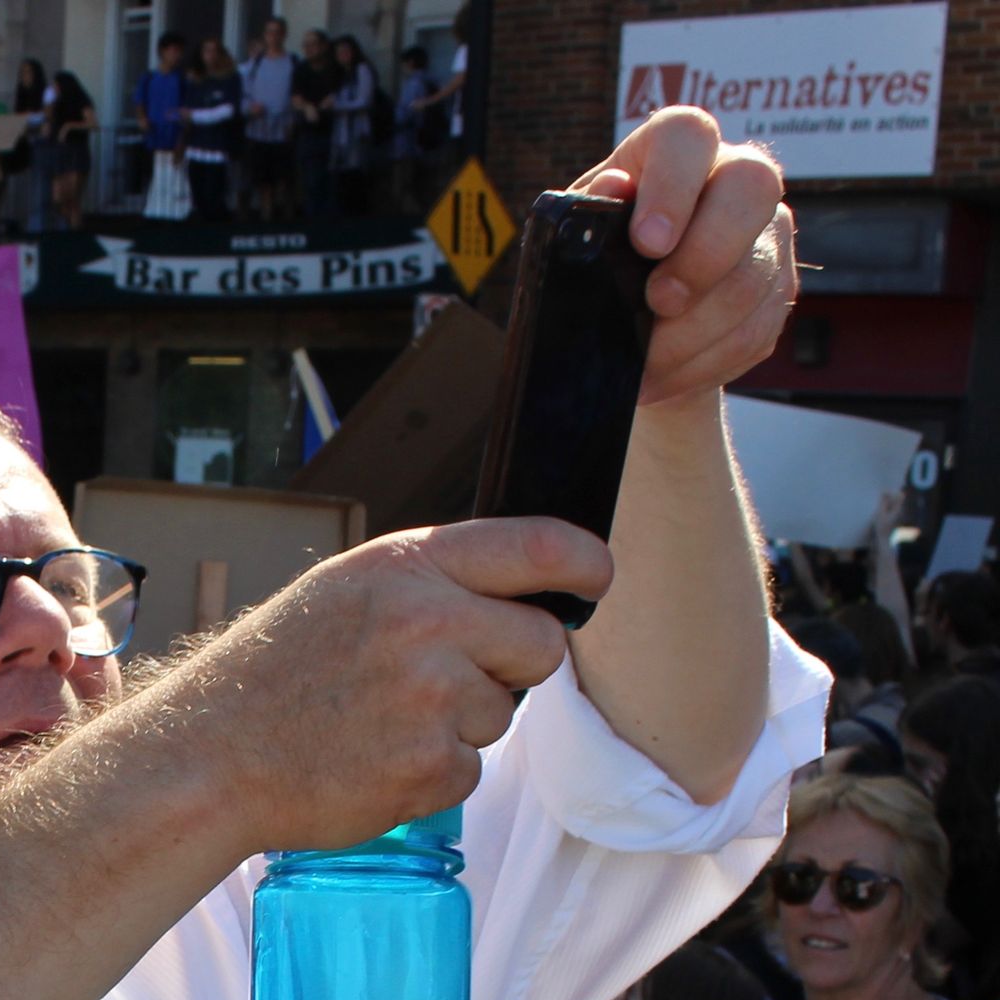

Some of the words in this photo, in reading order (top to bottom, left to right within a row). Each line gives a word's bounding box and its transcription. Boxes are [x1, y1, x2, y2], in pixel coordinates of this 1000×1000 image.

[624, 62, 931, 118] Alternatives
[126, 255, 199, 292] Bar
[218, 257, 301, 292] des
[320, 250, 423, 289] Pins
